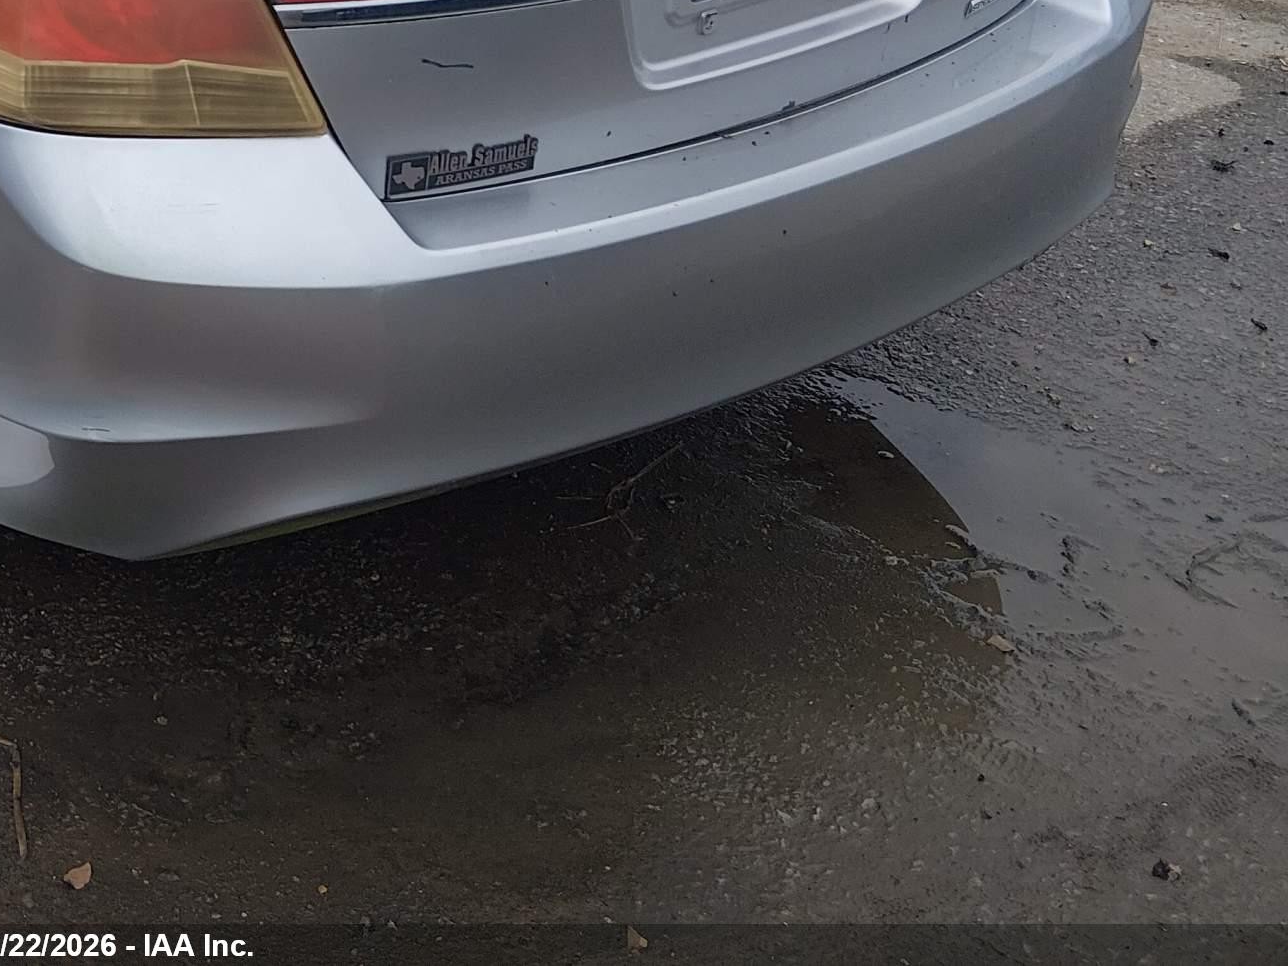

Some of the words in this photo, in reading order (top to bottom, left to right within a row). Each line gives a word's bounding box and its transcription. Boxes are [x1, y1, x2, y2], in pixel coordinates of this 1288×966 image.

[430, 151, 469, 175] Allen
[472, 134, 539, 167] Samuels
[435, 166, 495, 185] ARANSAS
[498, 159, 529, 175] PASS
